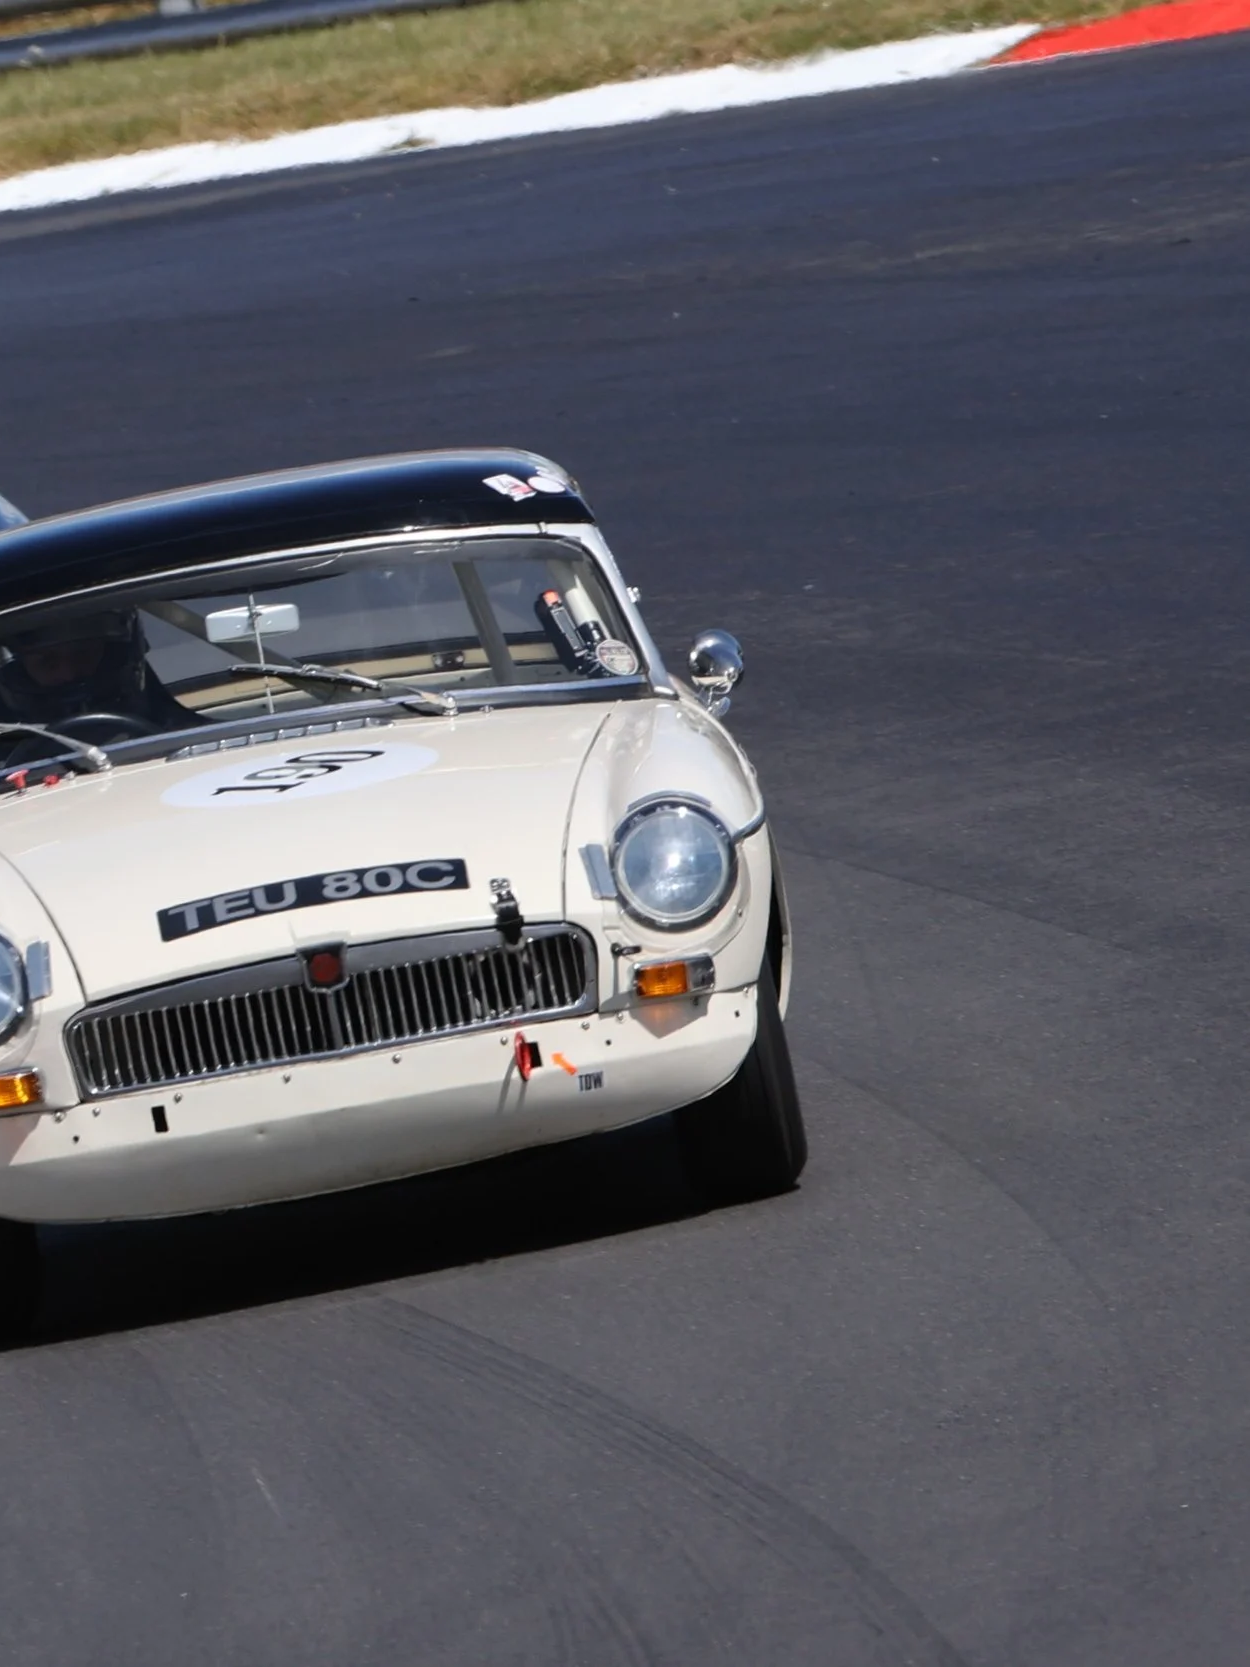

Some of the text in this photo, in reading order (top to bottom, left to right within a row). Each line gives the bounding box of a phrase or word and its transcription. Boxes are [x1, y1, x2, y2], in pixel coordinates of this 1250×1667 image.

[211, 750, 385, 796] 190
[167, 860, 456, 932] TEU 80C
[578, 1071, 604, 1091] TOW
